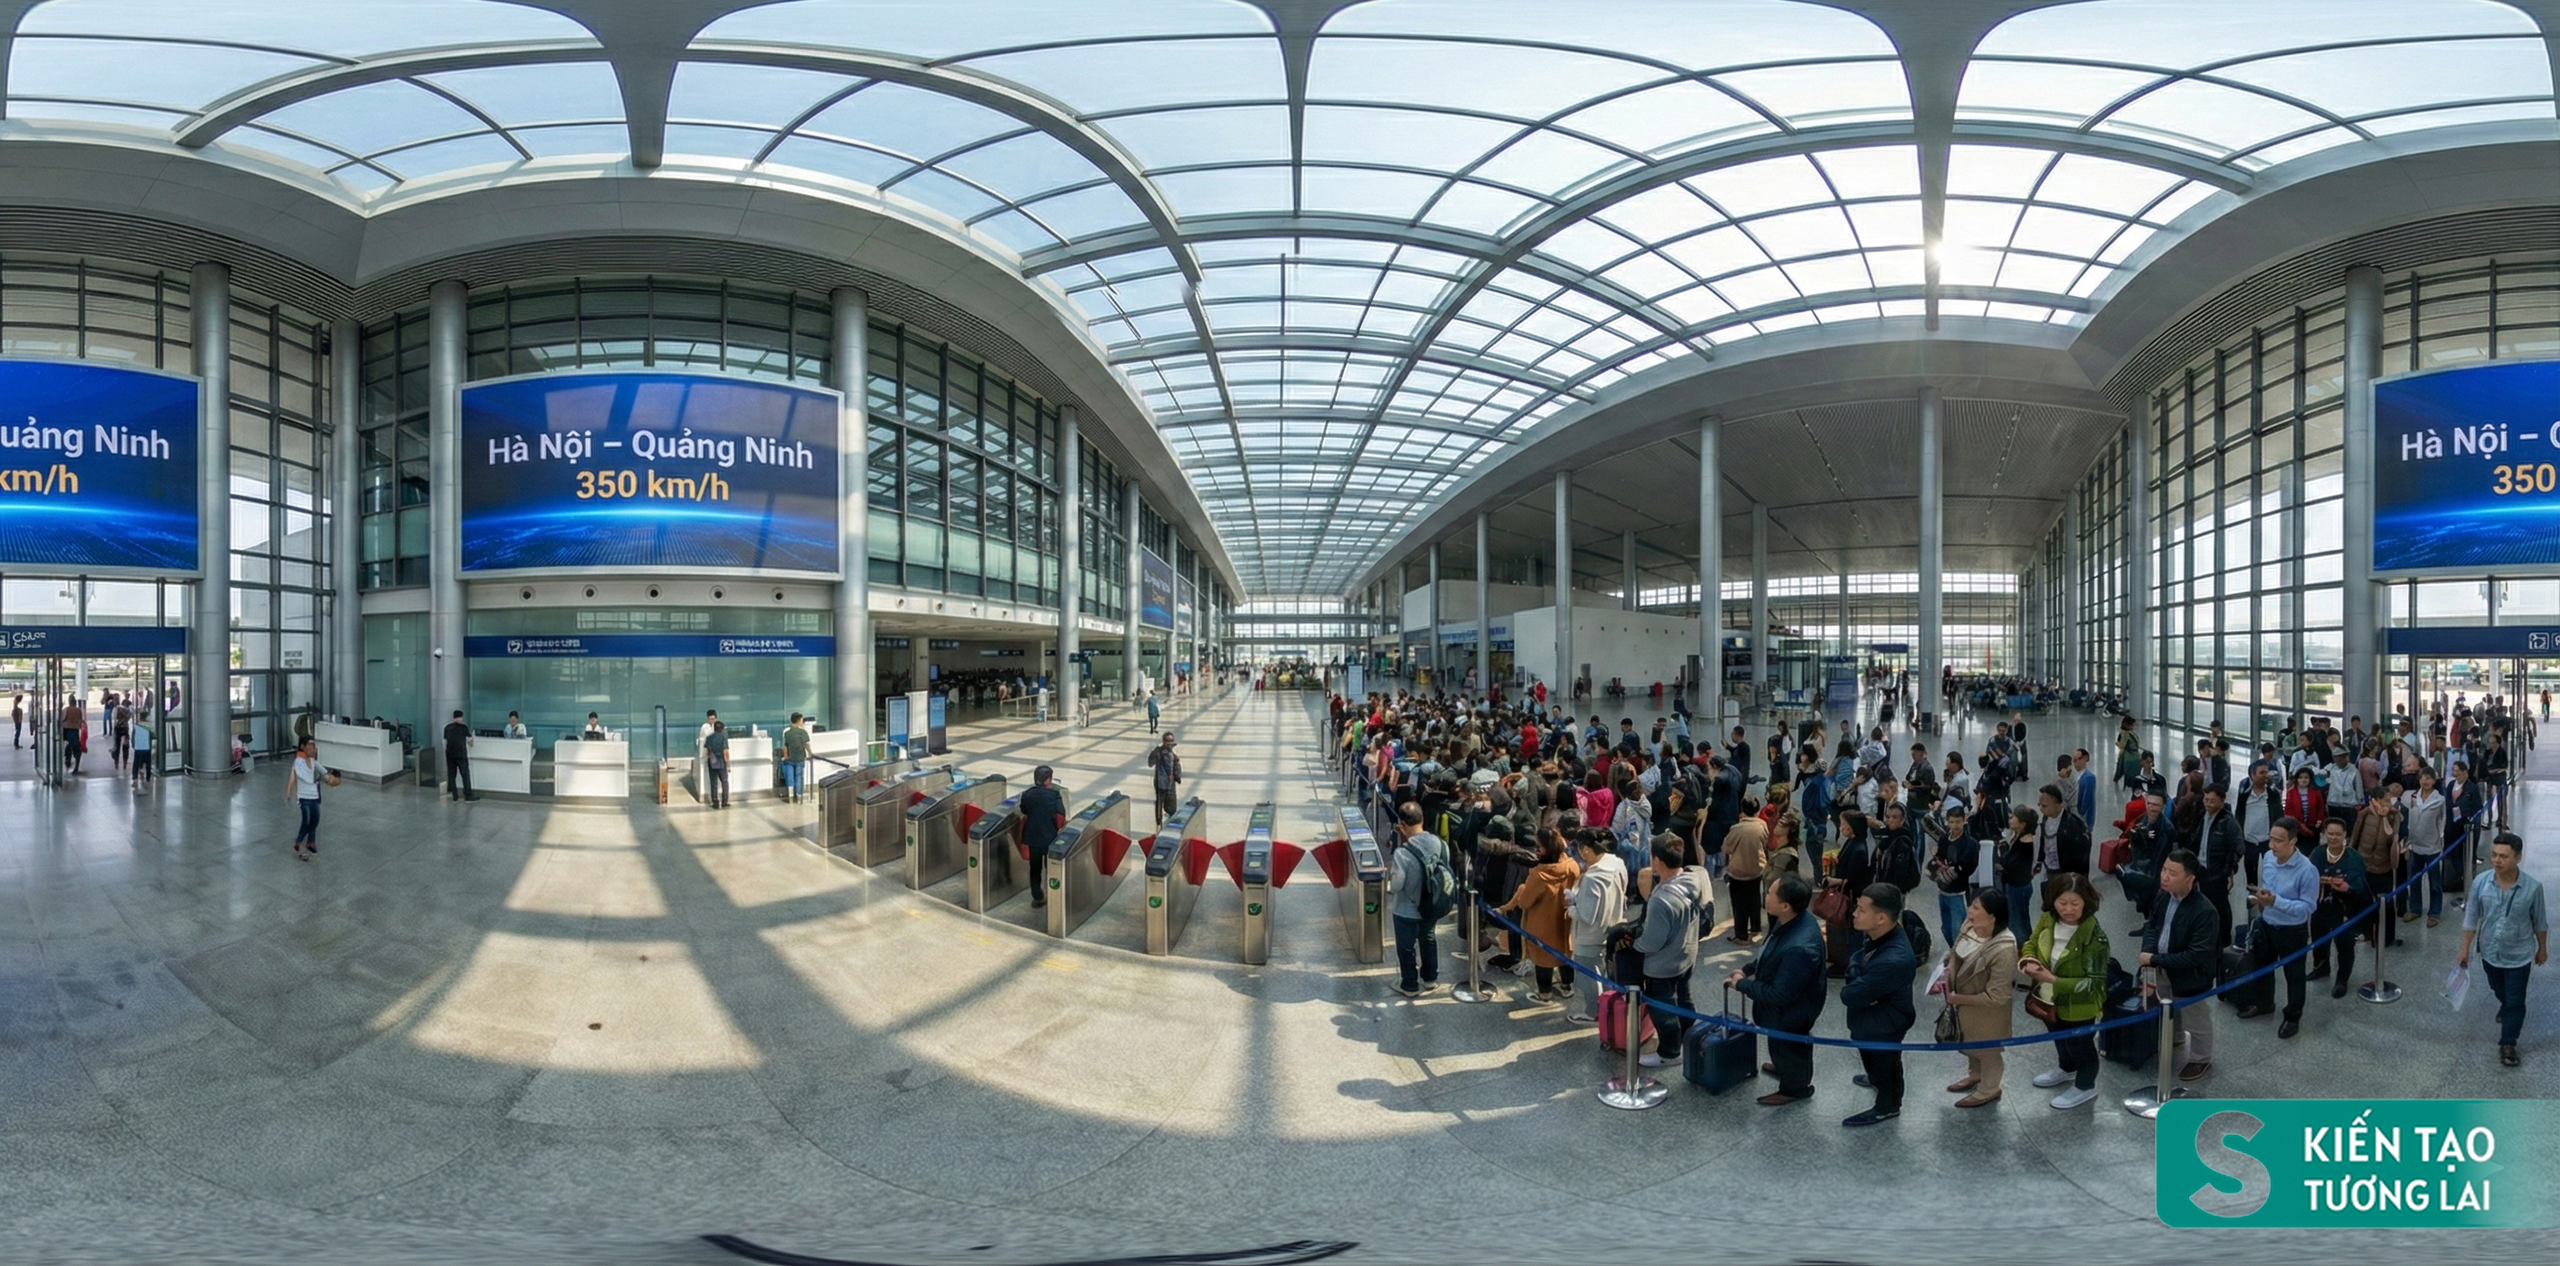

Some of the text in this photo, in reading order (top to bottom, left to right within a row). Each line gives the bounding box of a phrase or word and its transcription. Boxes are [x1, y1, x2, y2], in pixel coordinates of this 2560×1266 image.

[95, 424, 170, 460] Ninh
[488, 434, 529, 465] Hà
[539, 430, 592, 464] Nội
[632, 428, 735, 467] Quảng
[746, 436, 813, 469] Ninh
[2402, 429, 2443, 461] Hà
[2454, 423, 2508, 460] Nội
[576, 469, 729, 501] 350 km/h
[2493, 463, 2556, 495] 350
